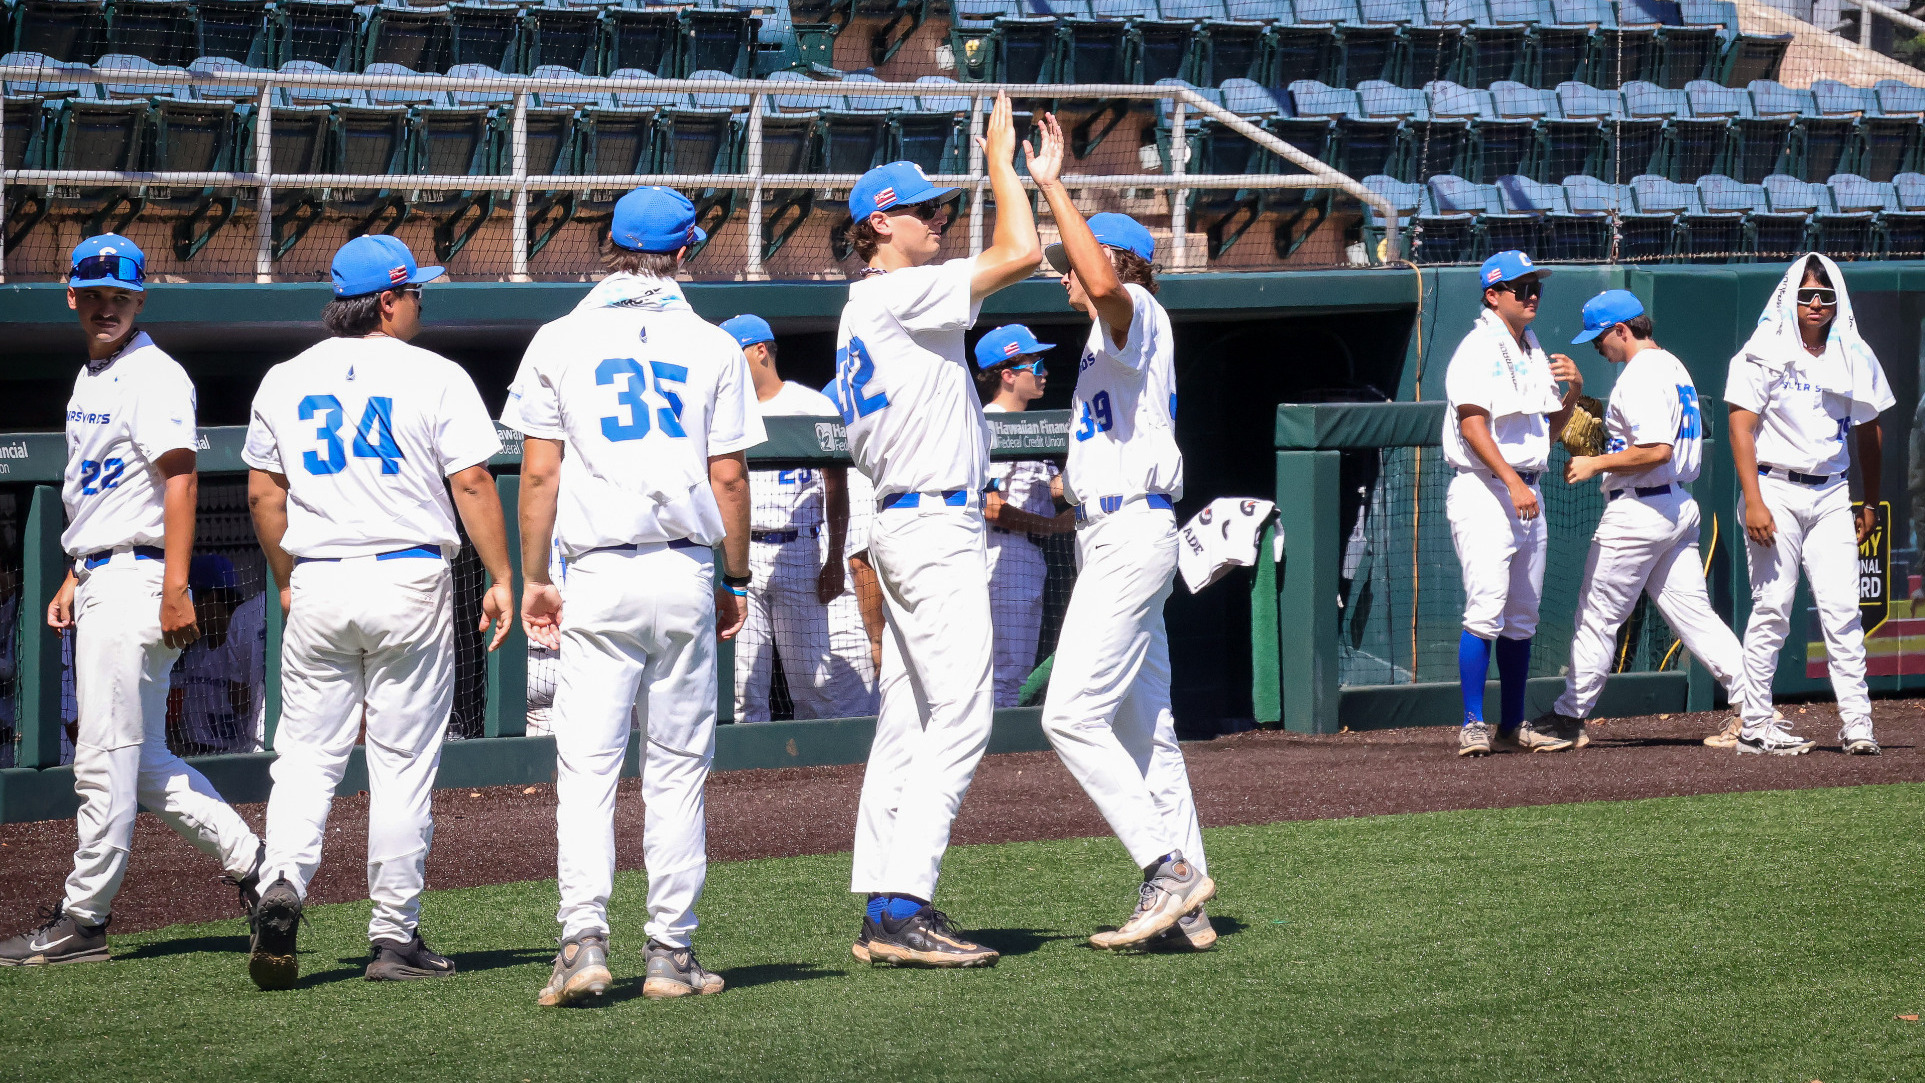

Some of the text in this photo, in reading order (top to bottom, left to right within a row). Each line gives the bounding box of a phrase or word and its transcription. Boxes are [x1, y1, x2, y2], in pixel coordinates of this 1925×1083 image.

[1519, 252, 1532, 267] C
[836, 335, 891, 427] 32
[594, 357, 689, 443] 35
[995, 418, 1070, 435] Hawaiian Financ
[1076, 390, 1113, 442] 39
[298, 394, 405, 476] 34
[997, 435, 1066, 449] Federal Credit Union
[0, 441, 29, 459] ncial
[81, 457, 124, 496] 22
[1860, 559, 1882, 574] NAL
[1860, 576, 1882, 599] RD
